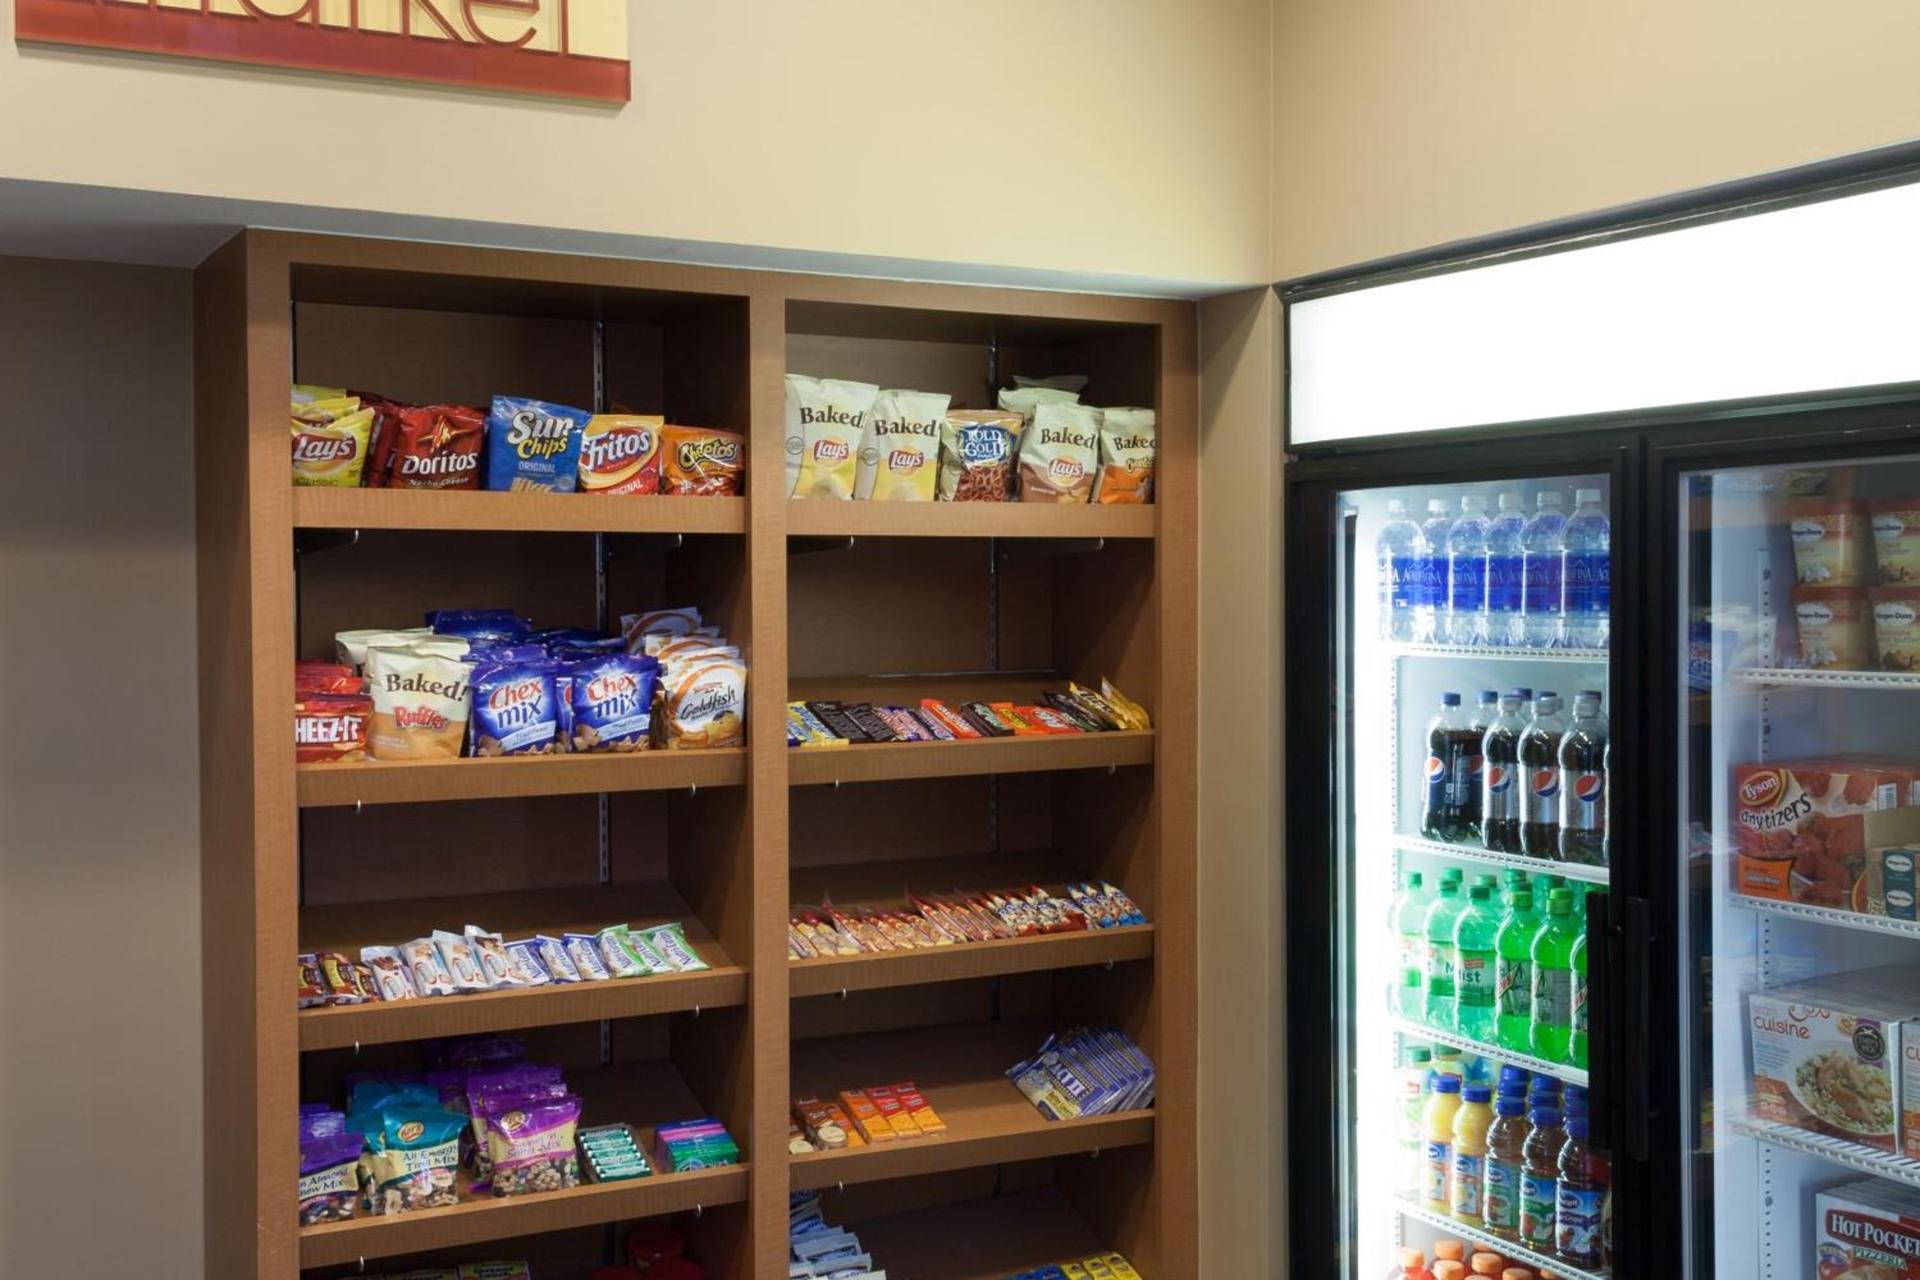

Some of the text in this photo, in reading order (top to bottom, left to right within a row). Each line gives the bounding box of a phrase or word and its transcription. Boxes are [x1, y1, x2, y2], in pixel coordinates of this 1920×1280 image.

[508, 411, 573, 443] Sun
[517, 437, 567, 459] Chips
[583, 431, 650, 469] Fritos
[402, 451, 478, 475] Doritos
[387, 673, 466, 702] Baked!
[489, 677, 542, 711] Chex
[587, 673, 635, 701] Chex
[394, 705, 448, 729] Ruffles
[499, 694, 542, 728] mix
[595, 690, 637, 720] mix
[680, 686, 736, 720] Goldfish
[296, 716, 362, 743] HEEZ-IT
[1744, 775, 1777, 800] Tyson
[1753, 1016, 1810, 1039] cuisine
[1832, 1213, 1862, 1238] HOT
